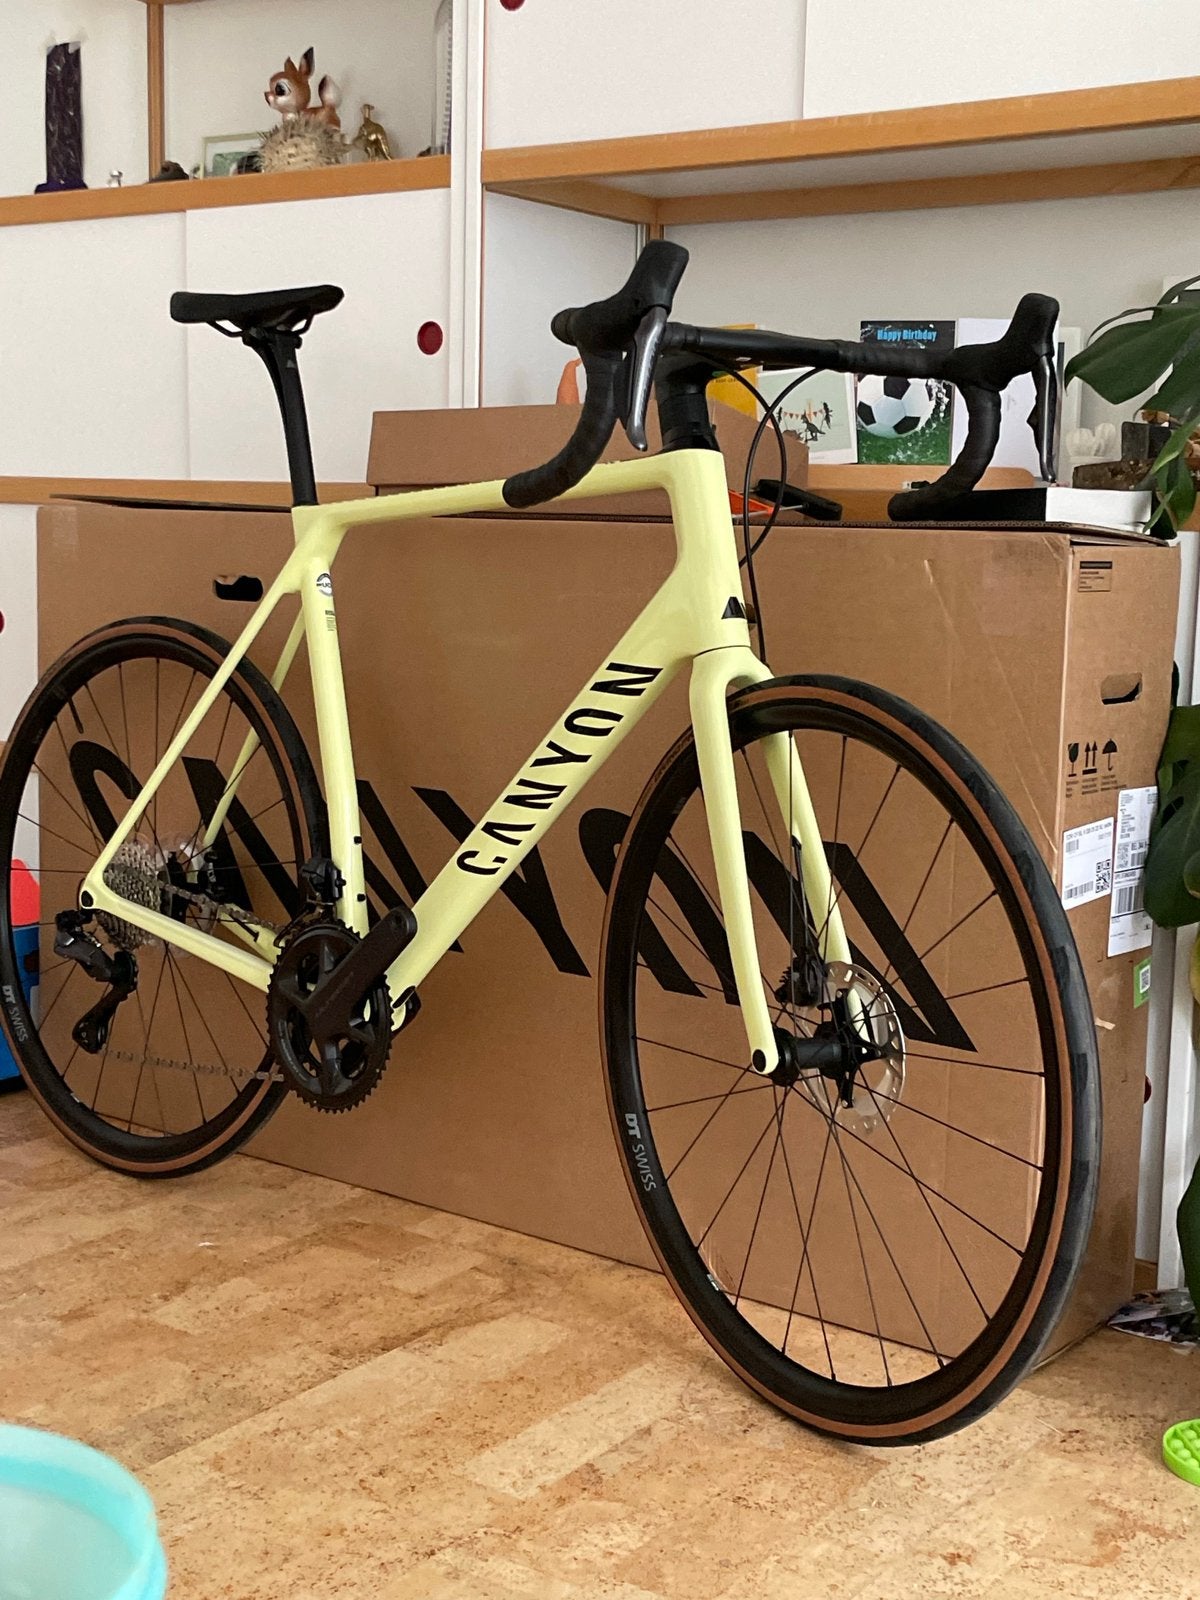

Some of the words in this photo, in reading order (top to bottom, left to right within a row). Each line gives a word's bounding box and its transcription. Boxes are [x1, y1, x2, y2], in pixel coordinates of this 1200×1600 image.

[877, 328, 902, 342] Happy
[902, 328, 937, 343] Birthday
[456, 662, 664, 876] CANYON
[2, 985, 16, 1004] DT
[9, 1007, 29, 1042] SWISS
[625, 1113, 641, 1139] DT
[632, 1143, 657, 1192] SWISS
